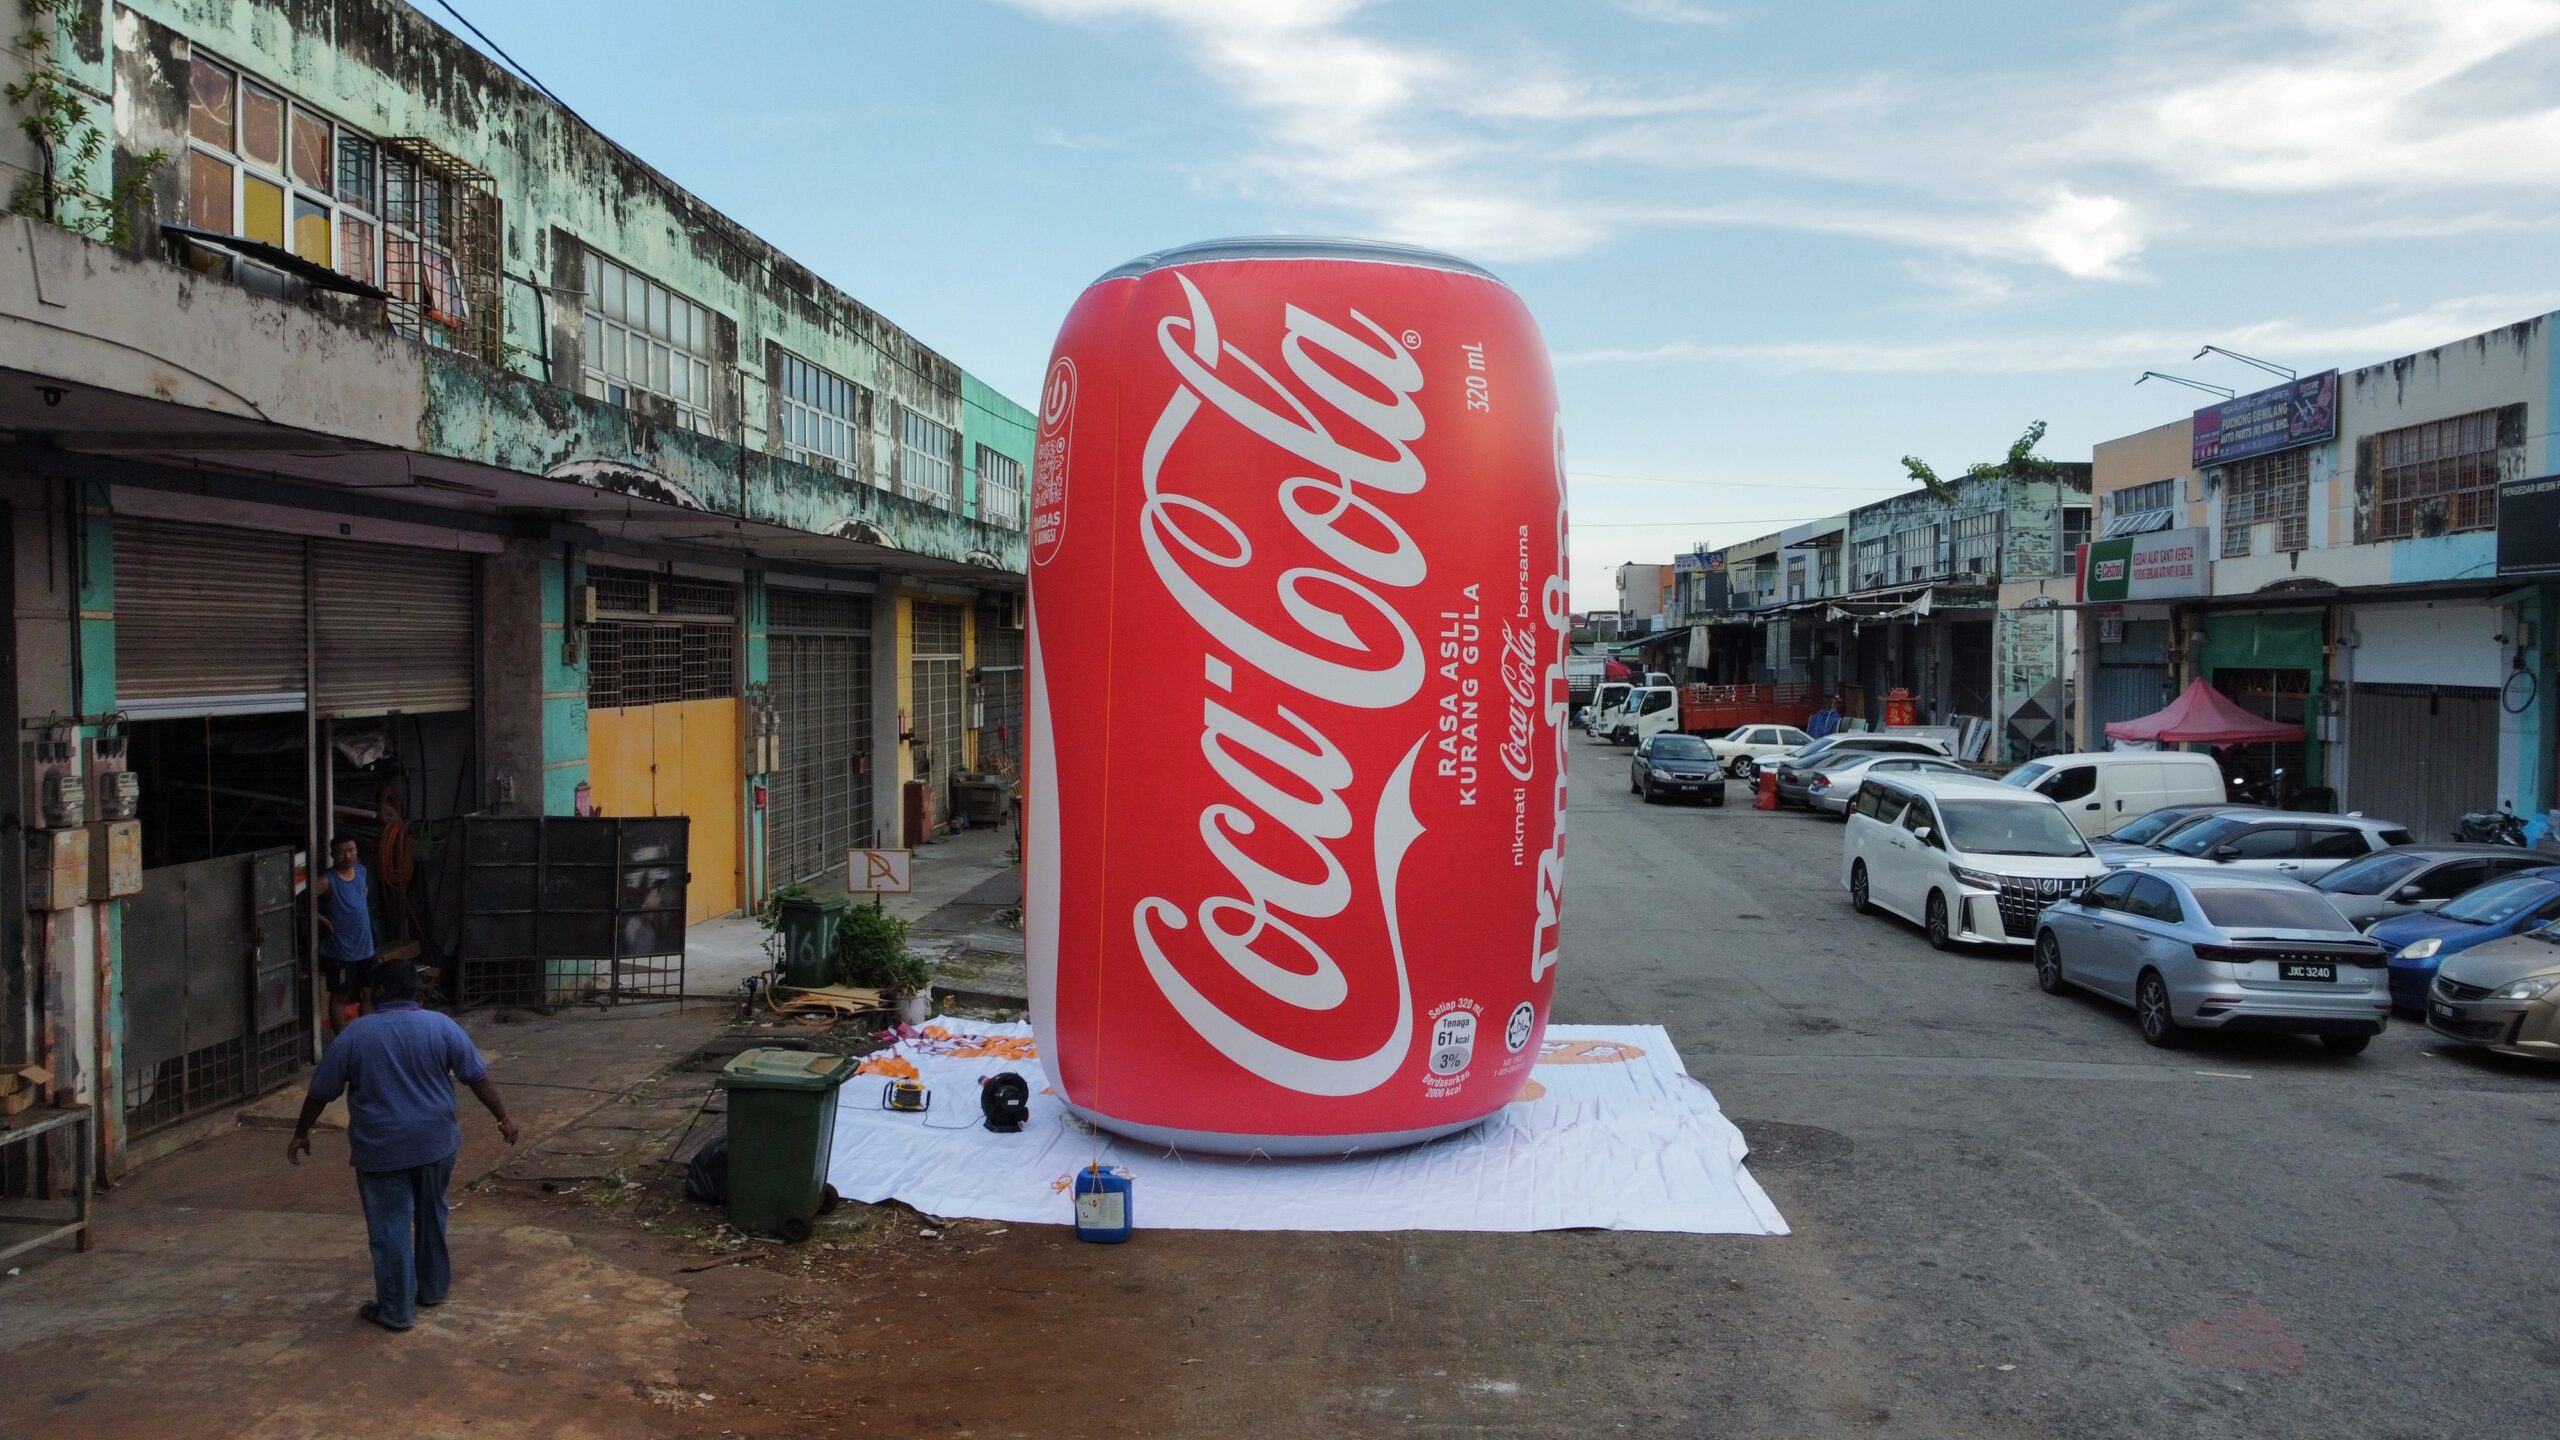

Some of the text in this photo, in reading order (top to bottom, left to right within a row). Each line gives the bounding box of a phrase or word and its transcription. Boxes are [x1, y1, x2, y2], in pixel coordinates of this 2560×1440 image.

[1462, 342, 1490, 413] 320 mL
[2221, 412, 2252, 430] PUCHONG
[2252, 402, 2288, 422] GEMILANG
[2220, 430, 2235, 444] AUTO
[2502, 484, 2536, 497] PENGEDAR
[1518, 524, 1528, 618] bersama
[2101, 562, 2122, 578] Castrol
[1438, 611, 1459, 776] RASA ASLI
[1460, 583, 1480, 805] KURANG GULA
[1513, 787, 1526, 866] nikmati
[2287, 966, 2330, 978] JXC 3240
[1428, 1000, 1456, 1019] Setiap
[1457, 997, 1473, 1009] 320
[1443, 1018, 1470, 1029] Tenaga
[1438, 1031, 1470, 1047] 61 kcal
[1440, 1053, 1461, 1069] 3%
[1422, 1070, 1470, 1088] Berdasarkan
[1425, 1084, 1462, 1098] 2000 kcal
